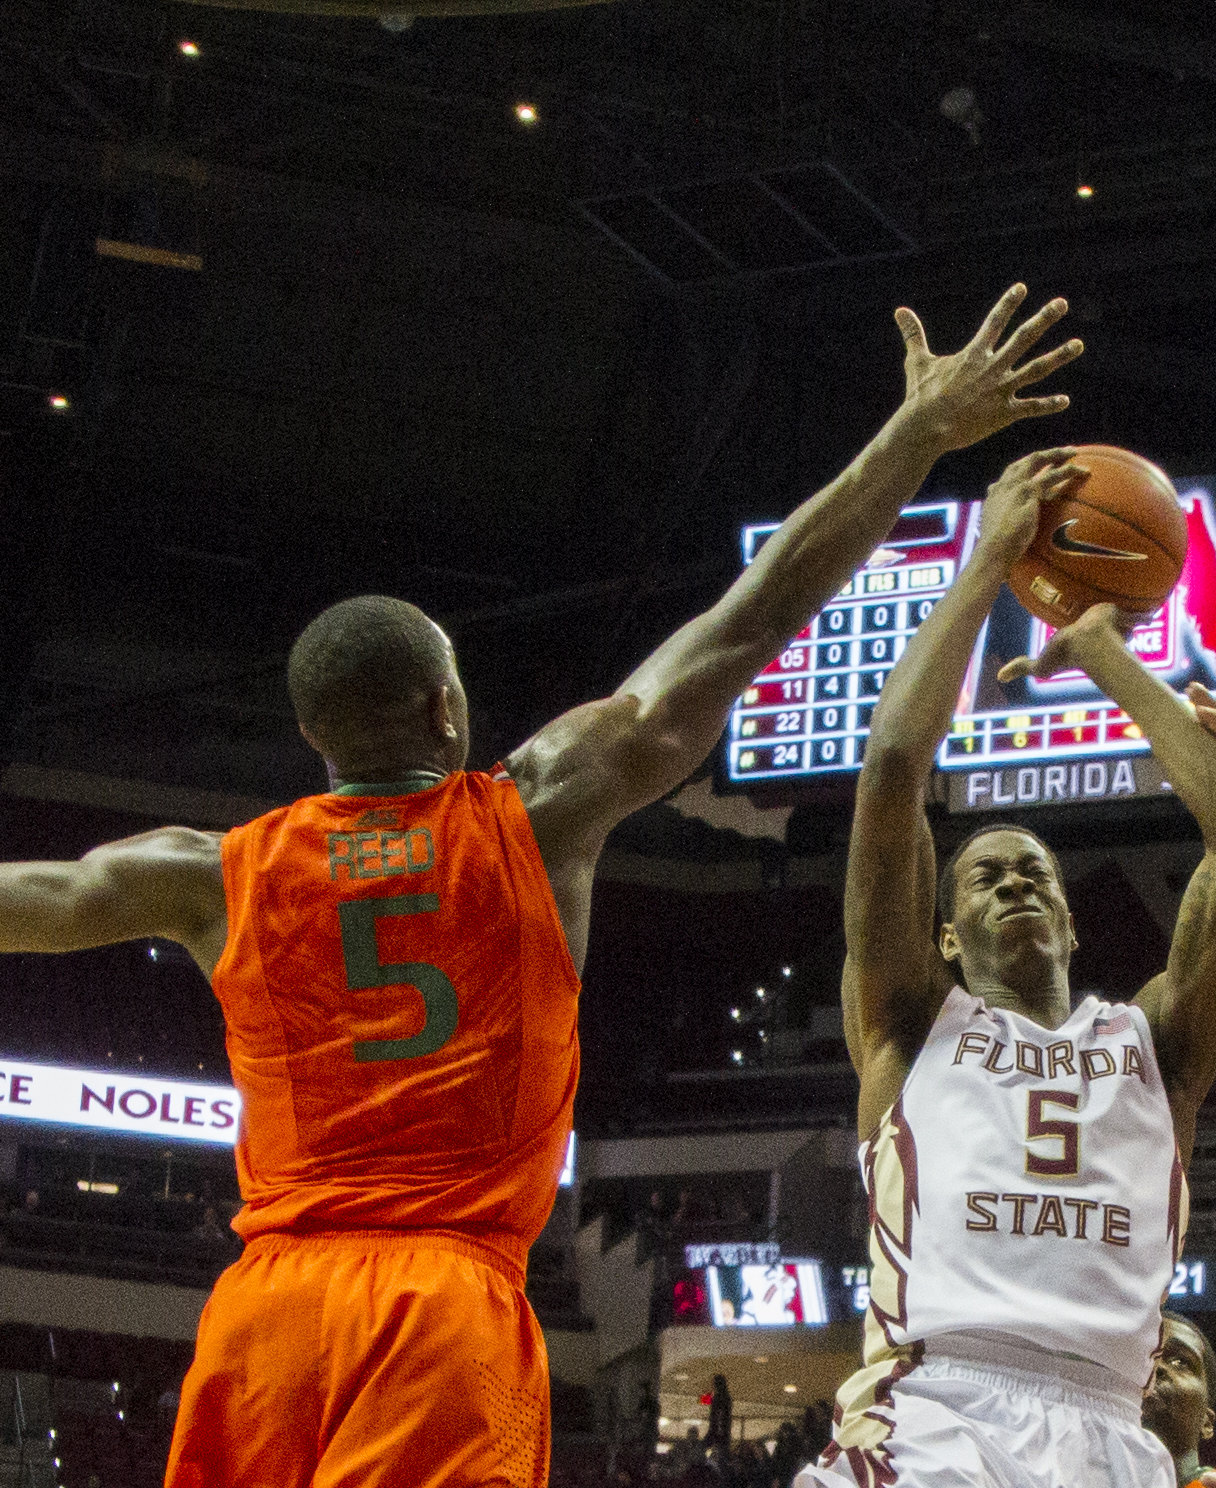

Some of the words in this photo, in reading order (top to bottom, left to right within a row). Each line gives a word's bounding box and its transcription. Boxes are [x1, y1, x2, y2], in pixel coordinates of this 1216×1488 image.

[830, 611, 844, 631] 0
[874, 606, 888, 626] 0
[779, 649, 804, 669] 05
[828, 644, 842, 664] 0
[873, 639, 886, 659] 0
[782, 679, 803, 699] 11
[824, 674, 839, 694] 4
[776, 712, 800, 732] 22
[824, 708, 838, 728] 0
[773, 745, 798, 766] 24
[822, 740, 836, 760] 0
[967, 759, 1136, 807] FLORIDA
[327, 827, 435, 881] REED
[338, 893, 459, 1063] 5
[951, 1031, 1146, 1084] FLORDA
[80, 1083, 234, 1129] NOLES
[1024, 1088, 1081, 1179] 5
[965, 1191, 1131, 1247] STATE
